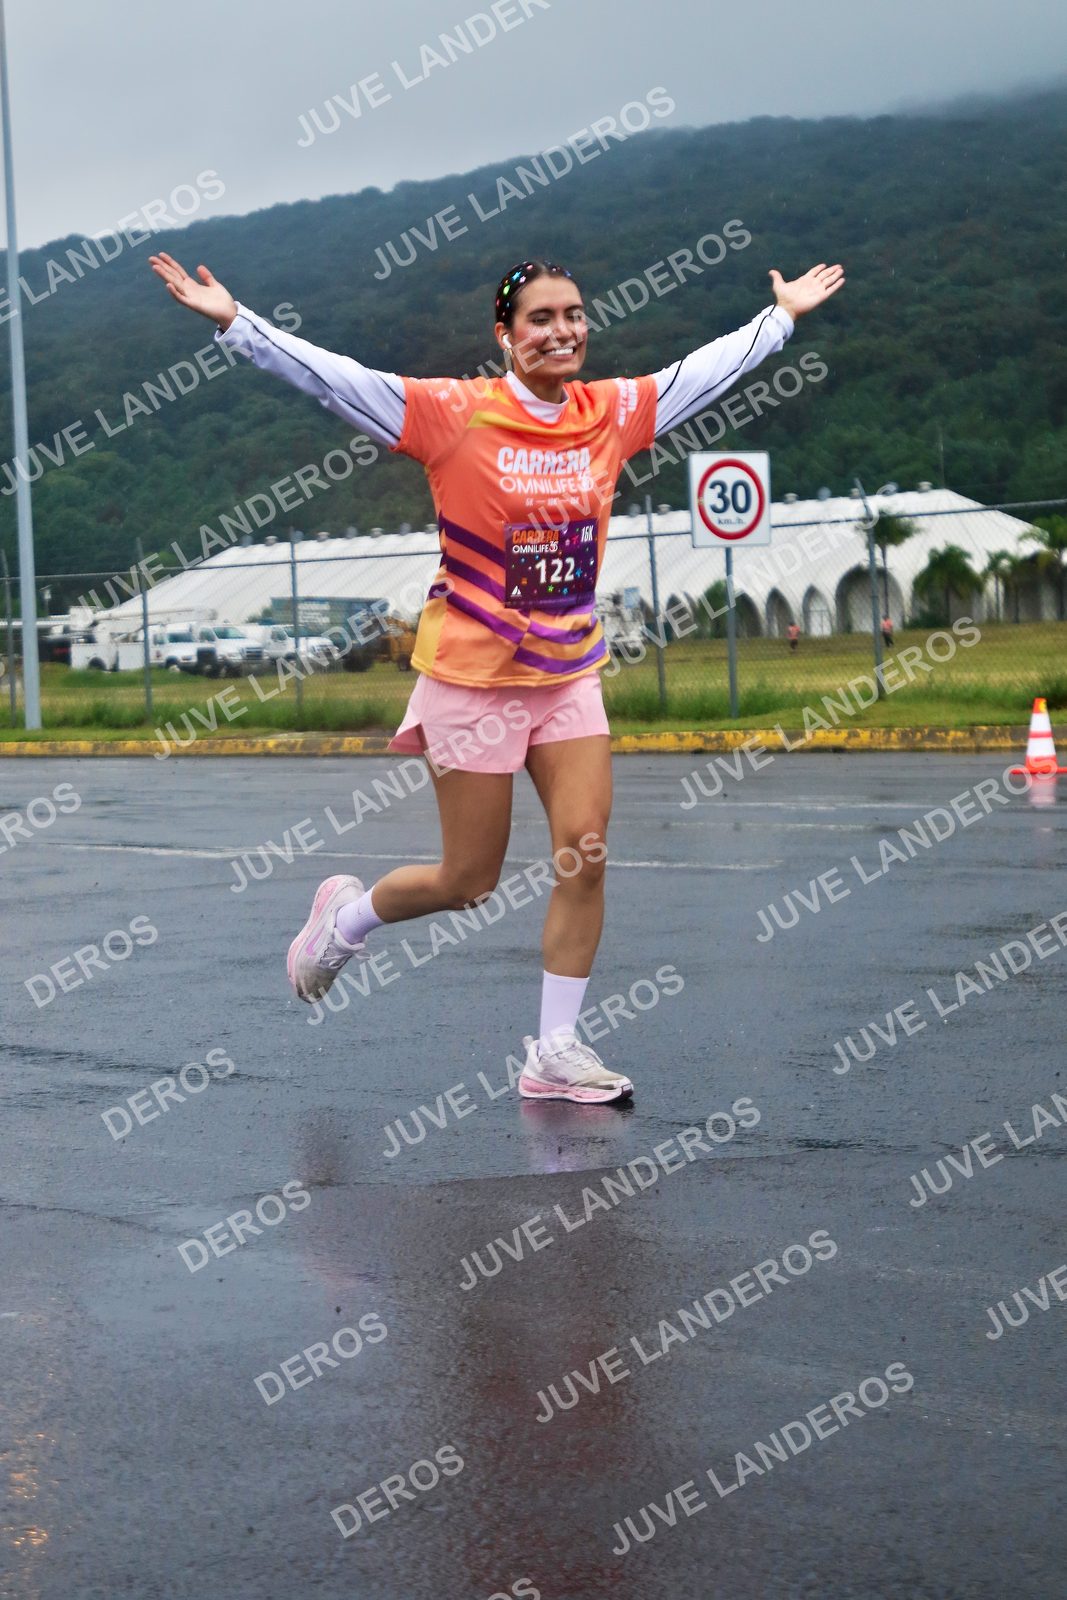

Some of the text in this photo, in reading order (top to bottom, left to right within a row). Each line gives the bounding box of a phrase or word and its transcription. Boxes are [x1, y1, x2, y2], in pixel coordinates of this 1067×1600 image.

[498, 446, 590, 475] CARRERA
[709, 480, 752, 514] 30
[512, 528, 560, 544] CARRERA
[512, 544, 550, 554] OMNILIFE
[535, 557, 575, 584] 122
